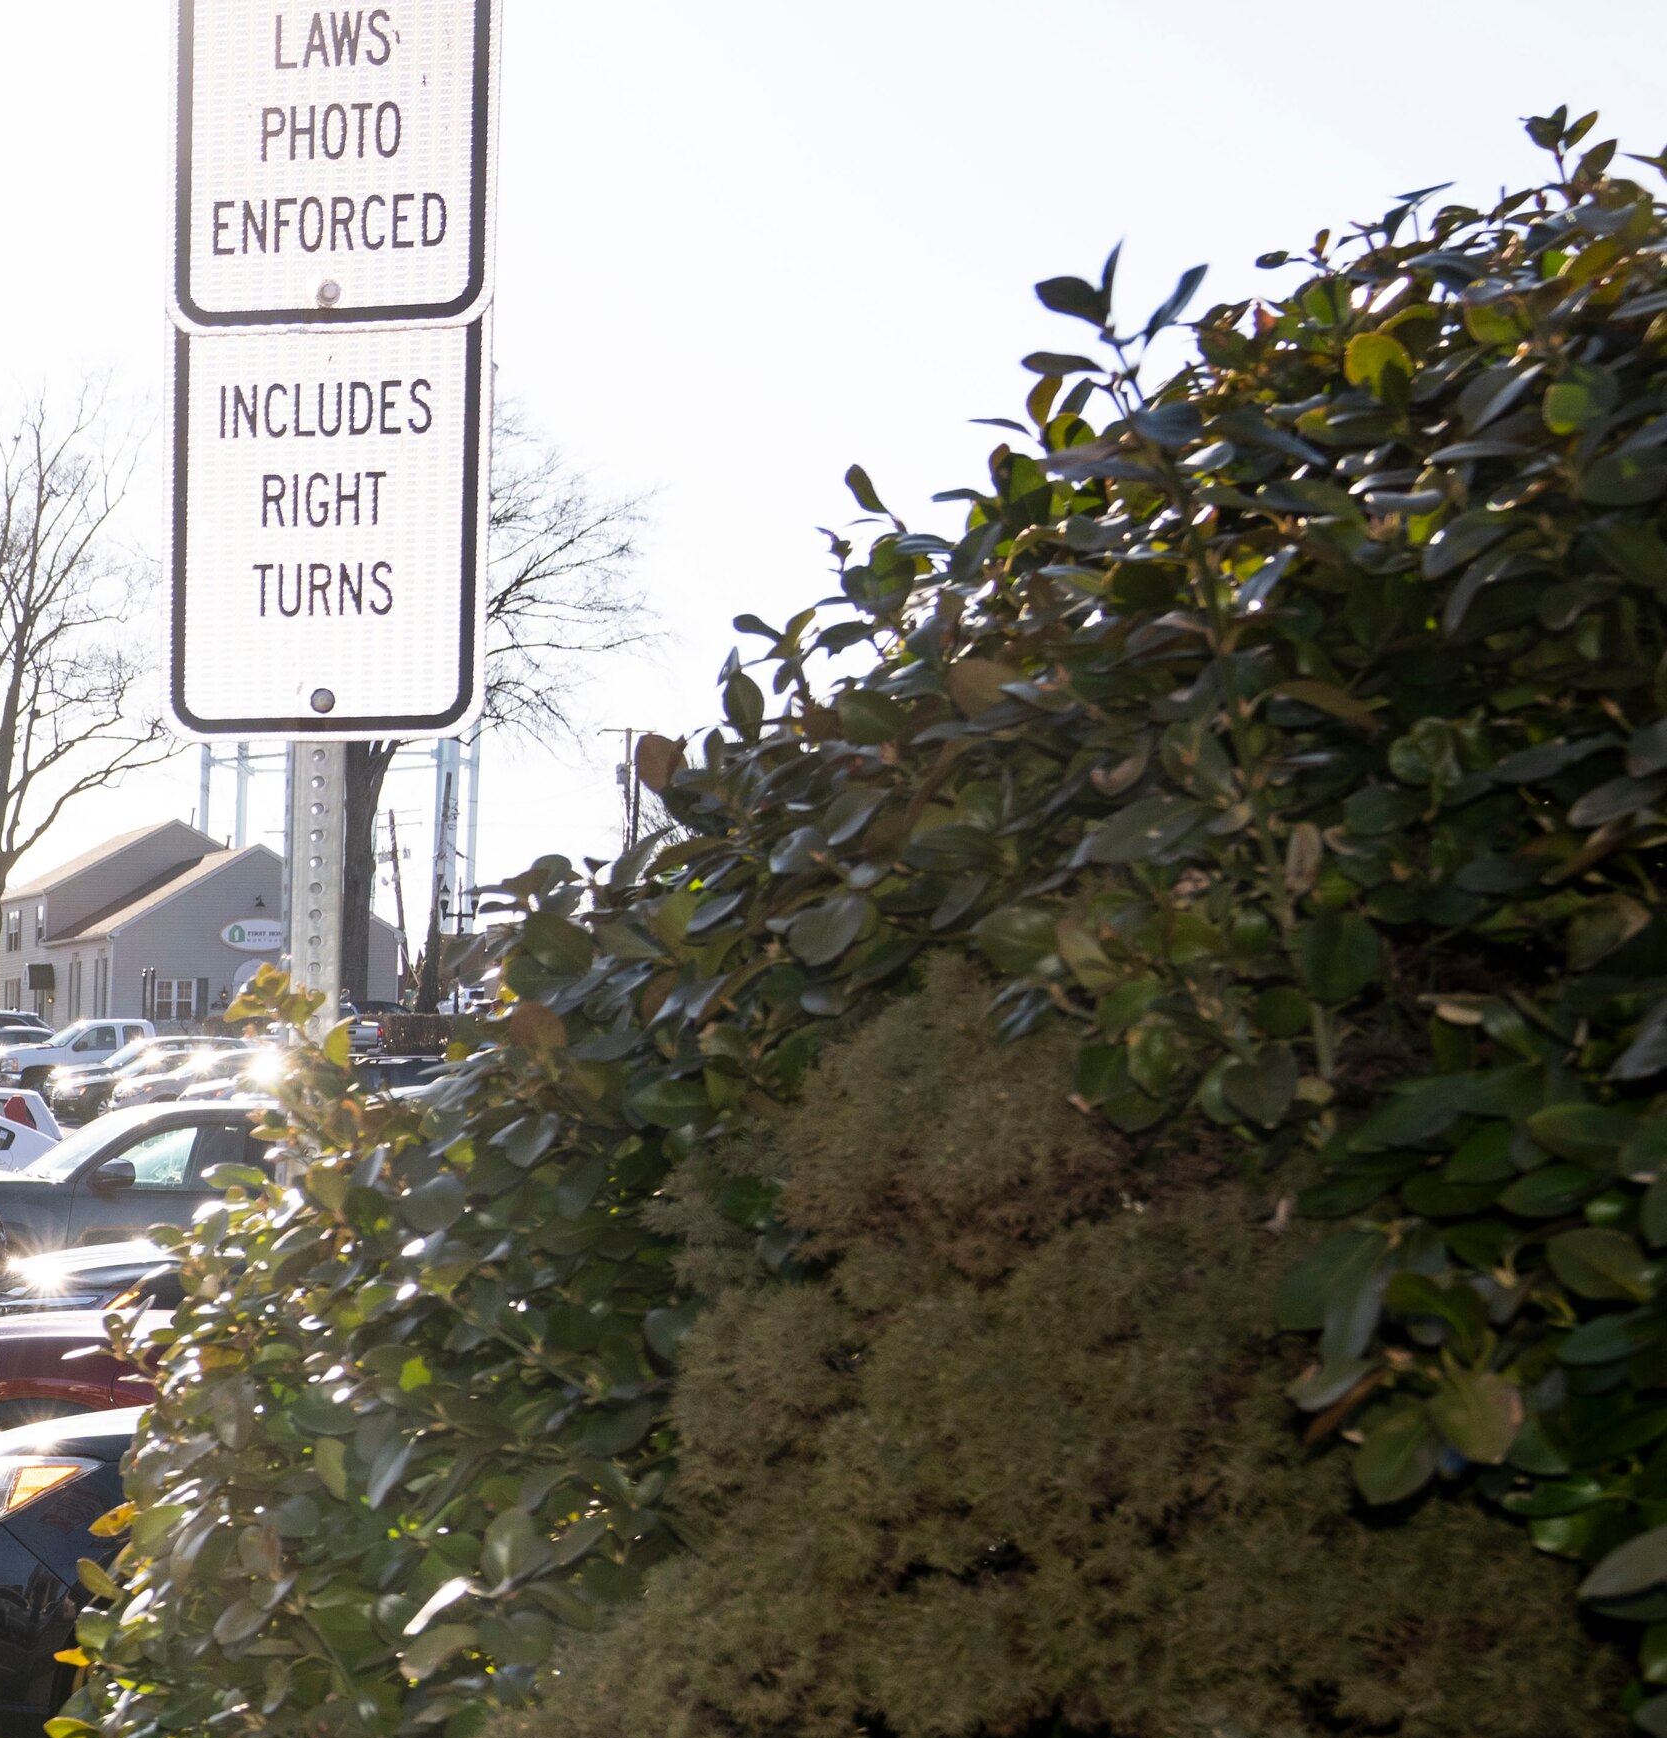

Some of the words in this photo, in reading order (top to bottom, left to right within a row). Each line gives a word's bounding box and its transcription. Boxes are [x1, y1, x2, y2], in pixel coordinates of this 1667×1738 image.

[275, 9, 392, 70] LAWS
[262, 102, 402, 161] PHOTO
[212, 192, 447, 256] ENFORCED
[220, 378, 433, 439] INCLUDES
[262, 470, 387, 528] RIGHT
[252, 561, 394, 617] TURNS
